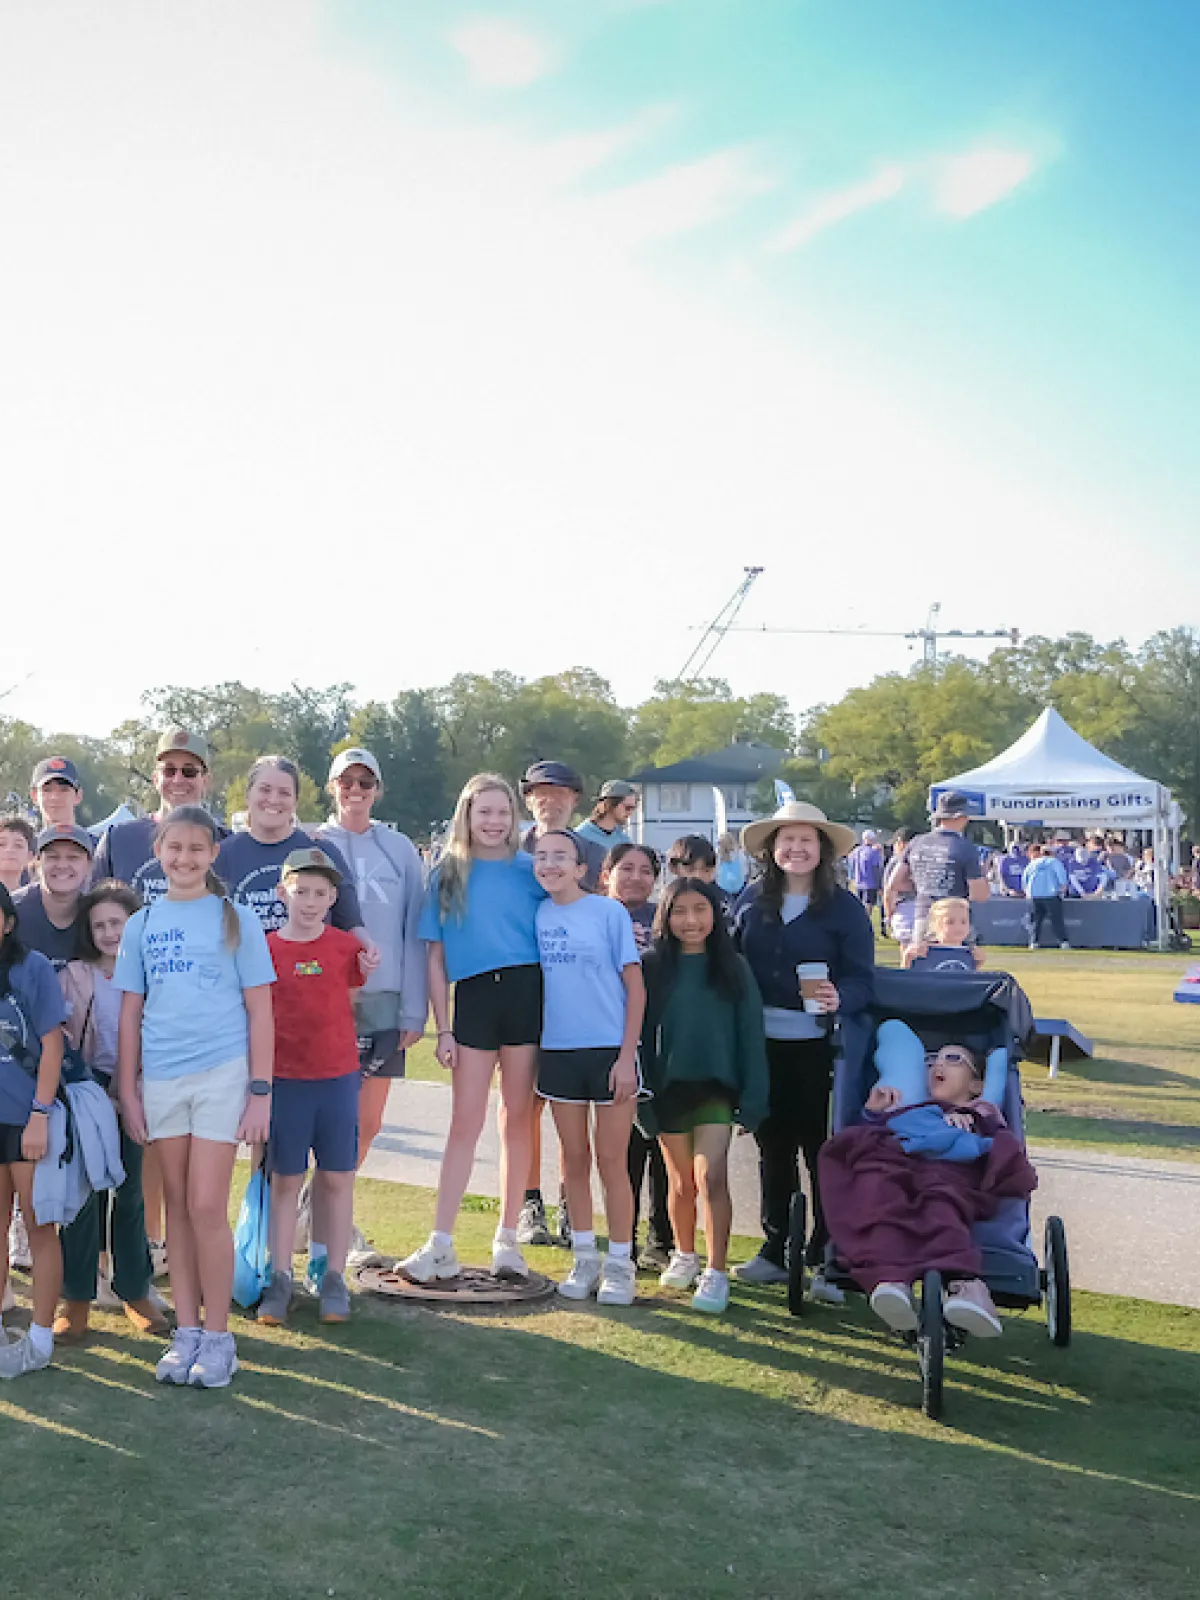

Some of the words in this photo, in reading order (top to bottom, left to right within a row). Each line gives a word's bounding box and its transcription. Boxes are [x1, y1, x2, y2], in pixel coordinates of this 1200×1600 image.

[990, 795, 1101, 812] Fundraising
[1106, 793, 1153, 808] Gifts
[146, 928, 185, 944] walk
